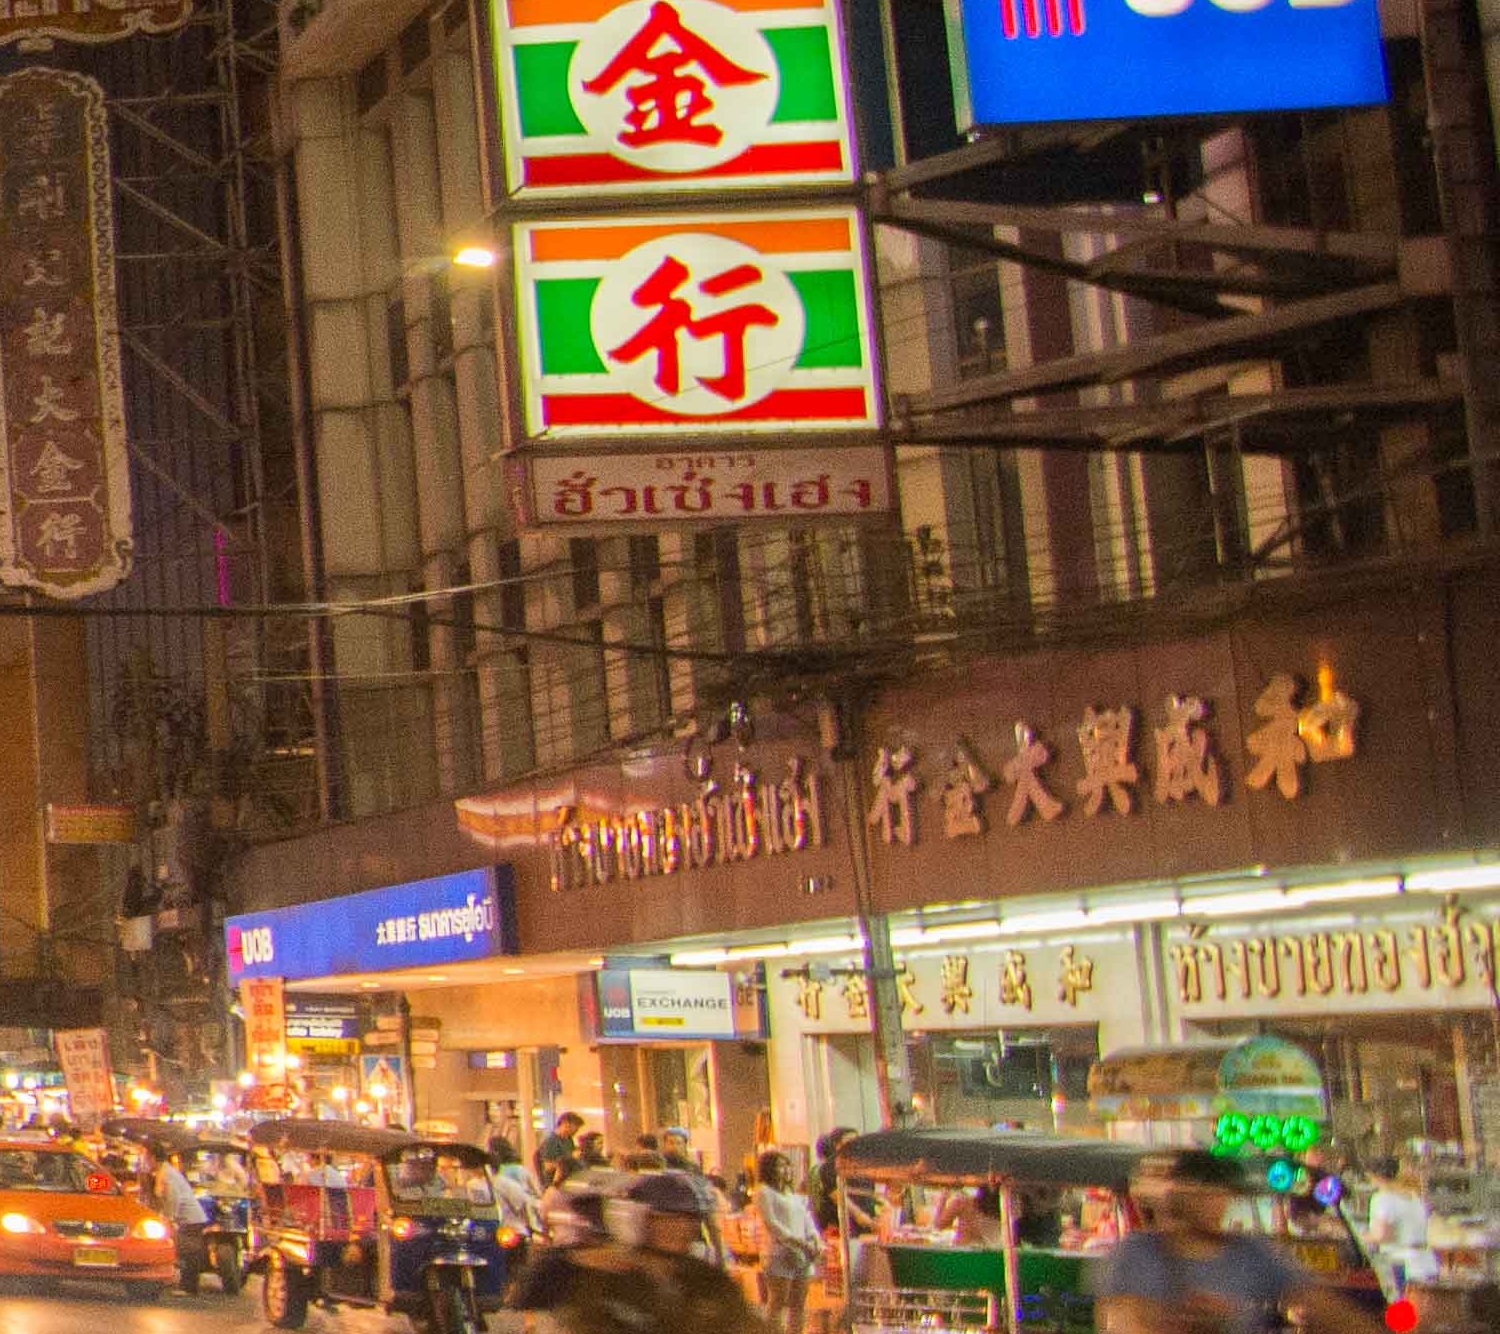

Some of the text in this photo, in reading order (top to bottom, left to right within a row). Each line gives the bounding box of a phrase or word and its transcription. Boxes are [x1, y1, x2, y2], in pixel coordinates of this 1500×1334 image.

[554, 471, 871, 516] ฮั่วเซ่งเฮง
[242, 927, 274, 965] UOB
[637, 996, 727, 1011] EXCHANGE
